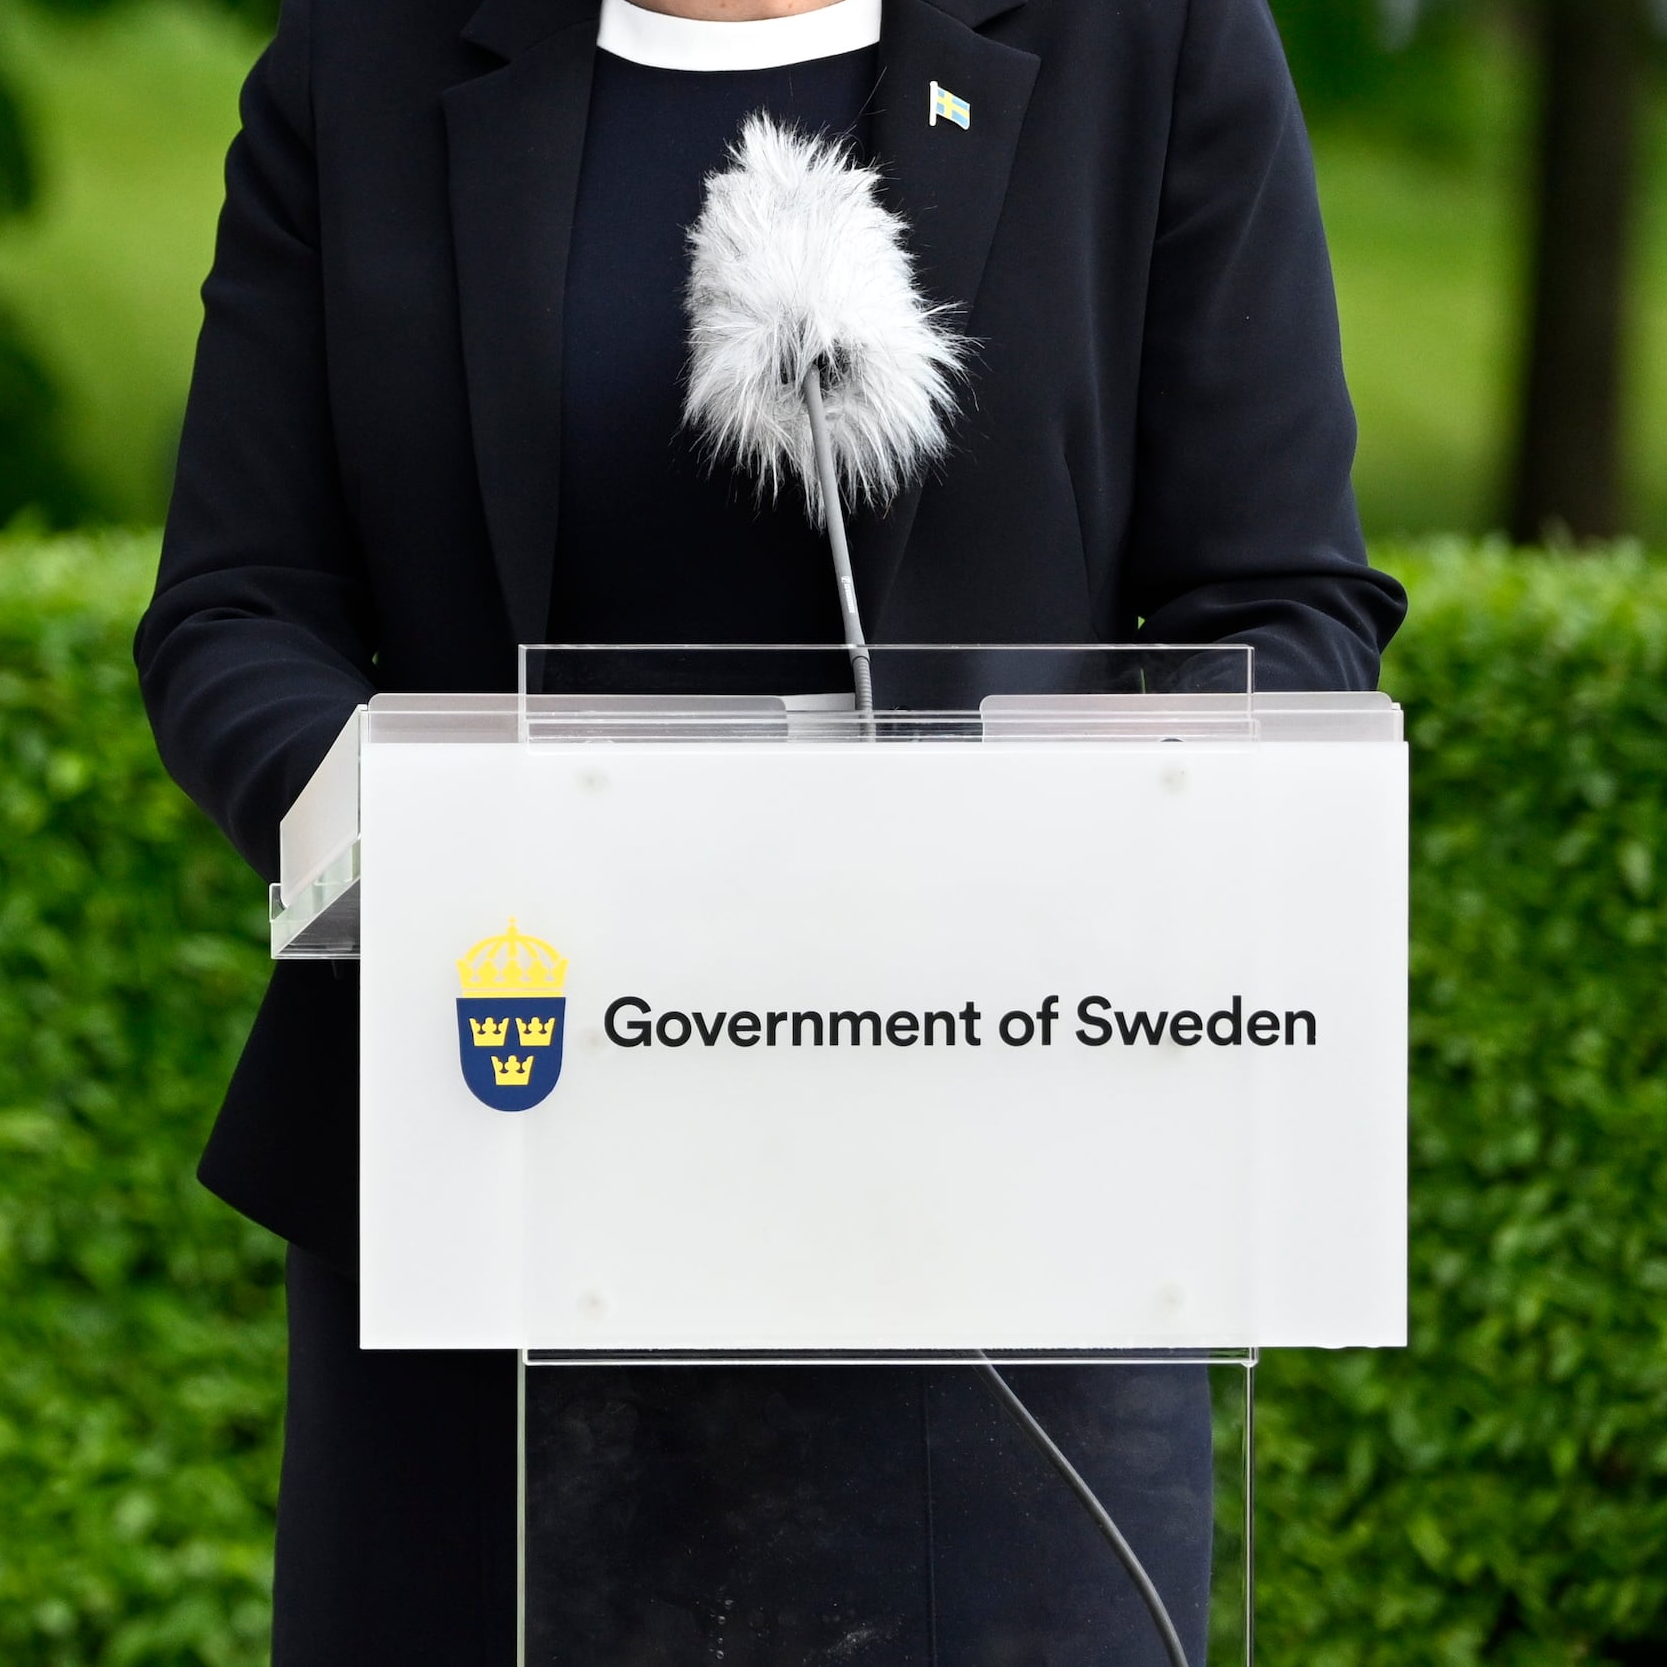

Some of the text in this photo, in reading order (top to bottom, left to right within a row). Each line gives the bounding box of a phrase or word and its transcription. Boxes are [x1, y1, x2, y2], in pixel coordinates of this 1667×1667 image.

[604, 994, 1317, 1048] Government of Sweden
